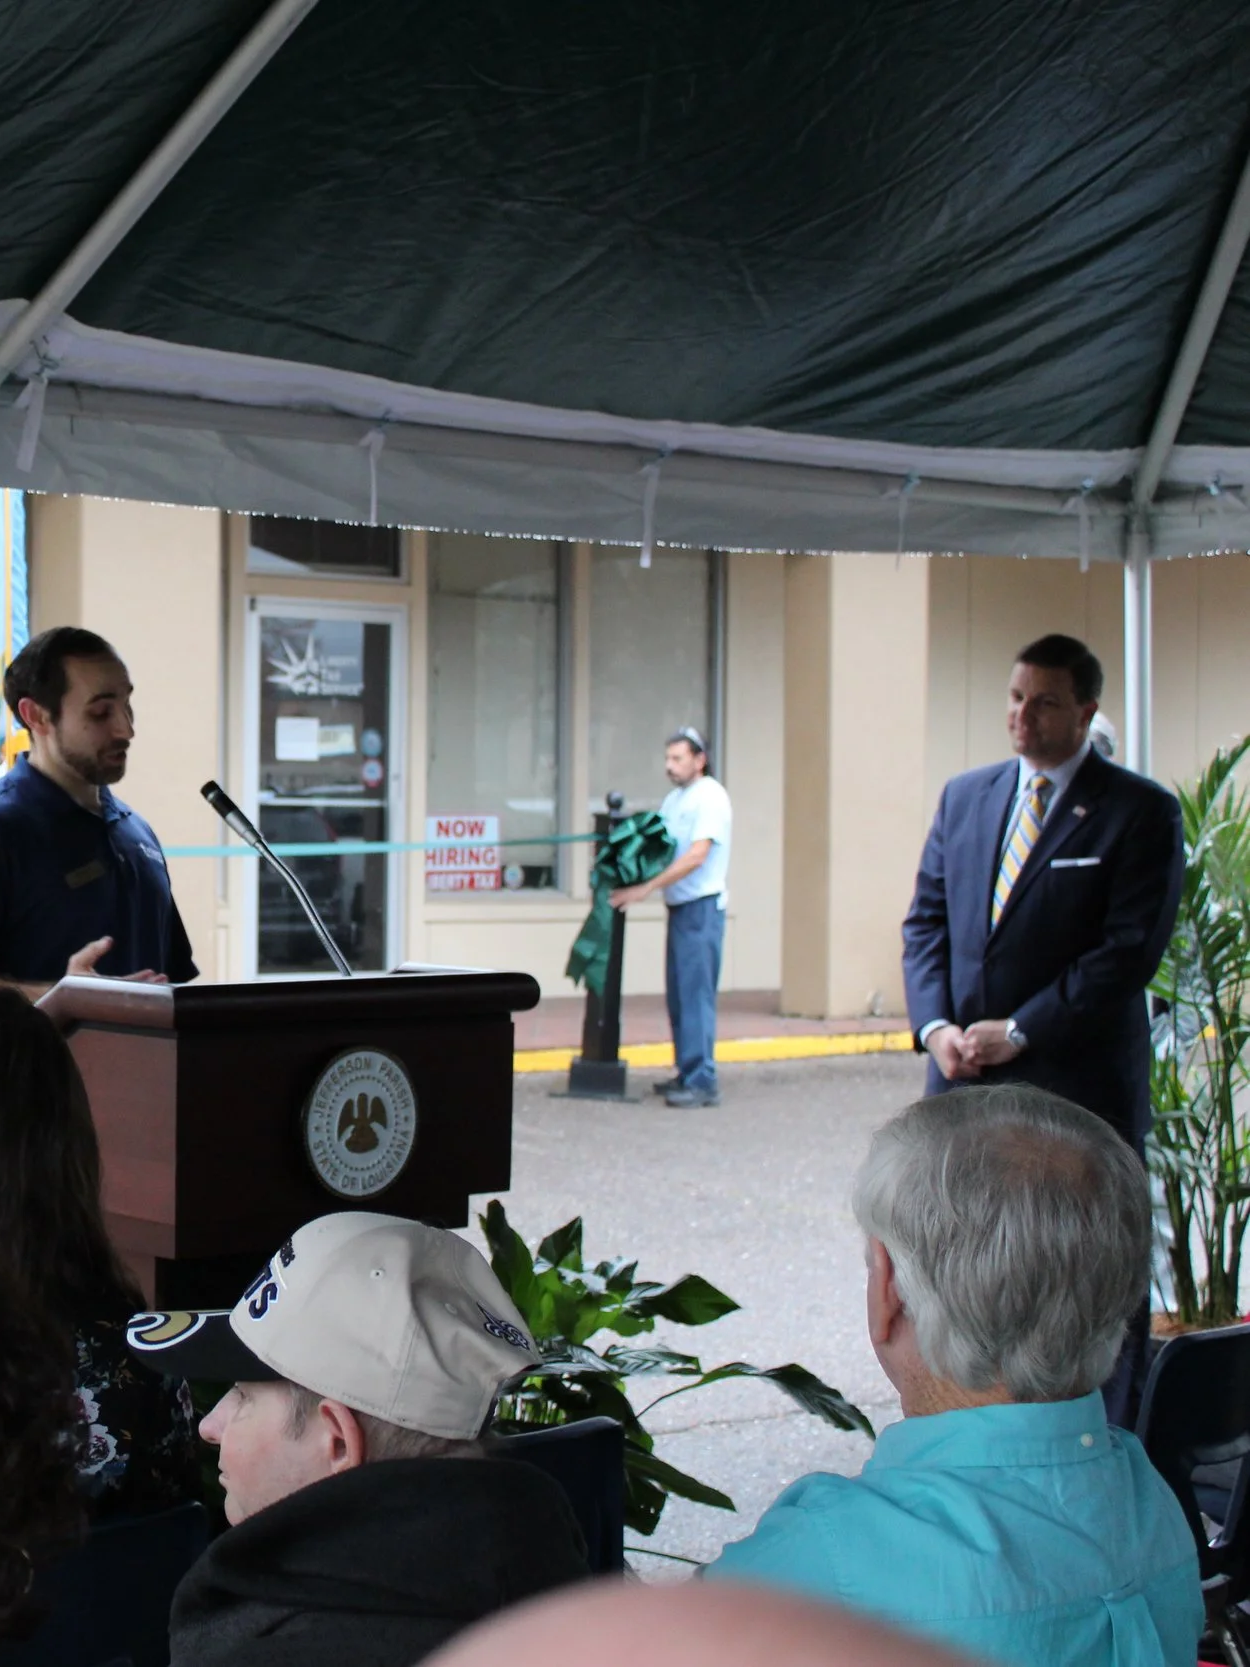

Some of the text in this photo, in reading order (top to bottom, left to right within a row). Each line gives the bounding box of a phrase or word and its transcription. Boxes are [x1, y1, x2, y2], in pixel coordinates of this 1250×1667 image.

[436, 820, 486, 838] NOW
[425, 847, 496, 866] HIRING
[313, 1057, 411, 1118] JEFFERSON PARISH
[313, 1130, 410, 1190] STATE OF LOUISIANA
